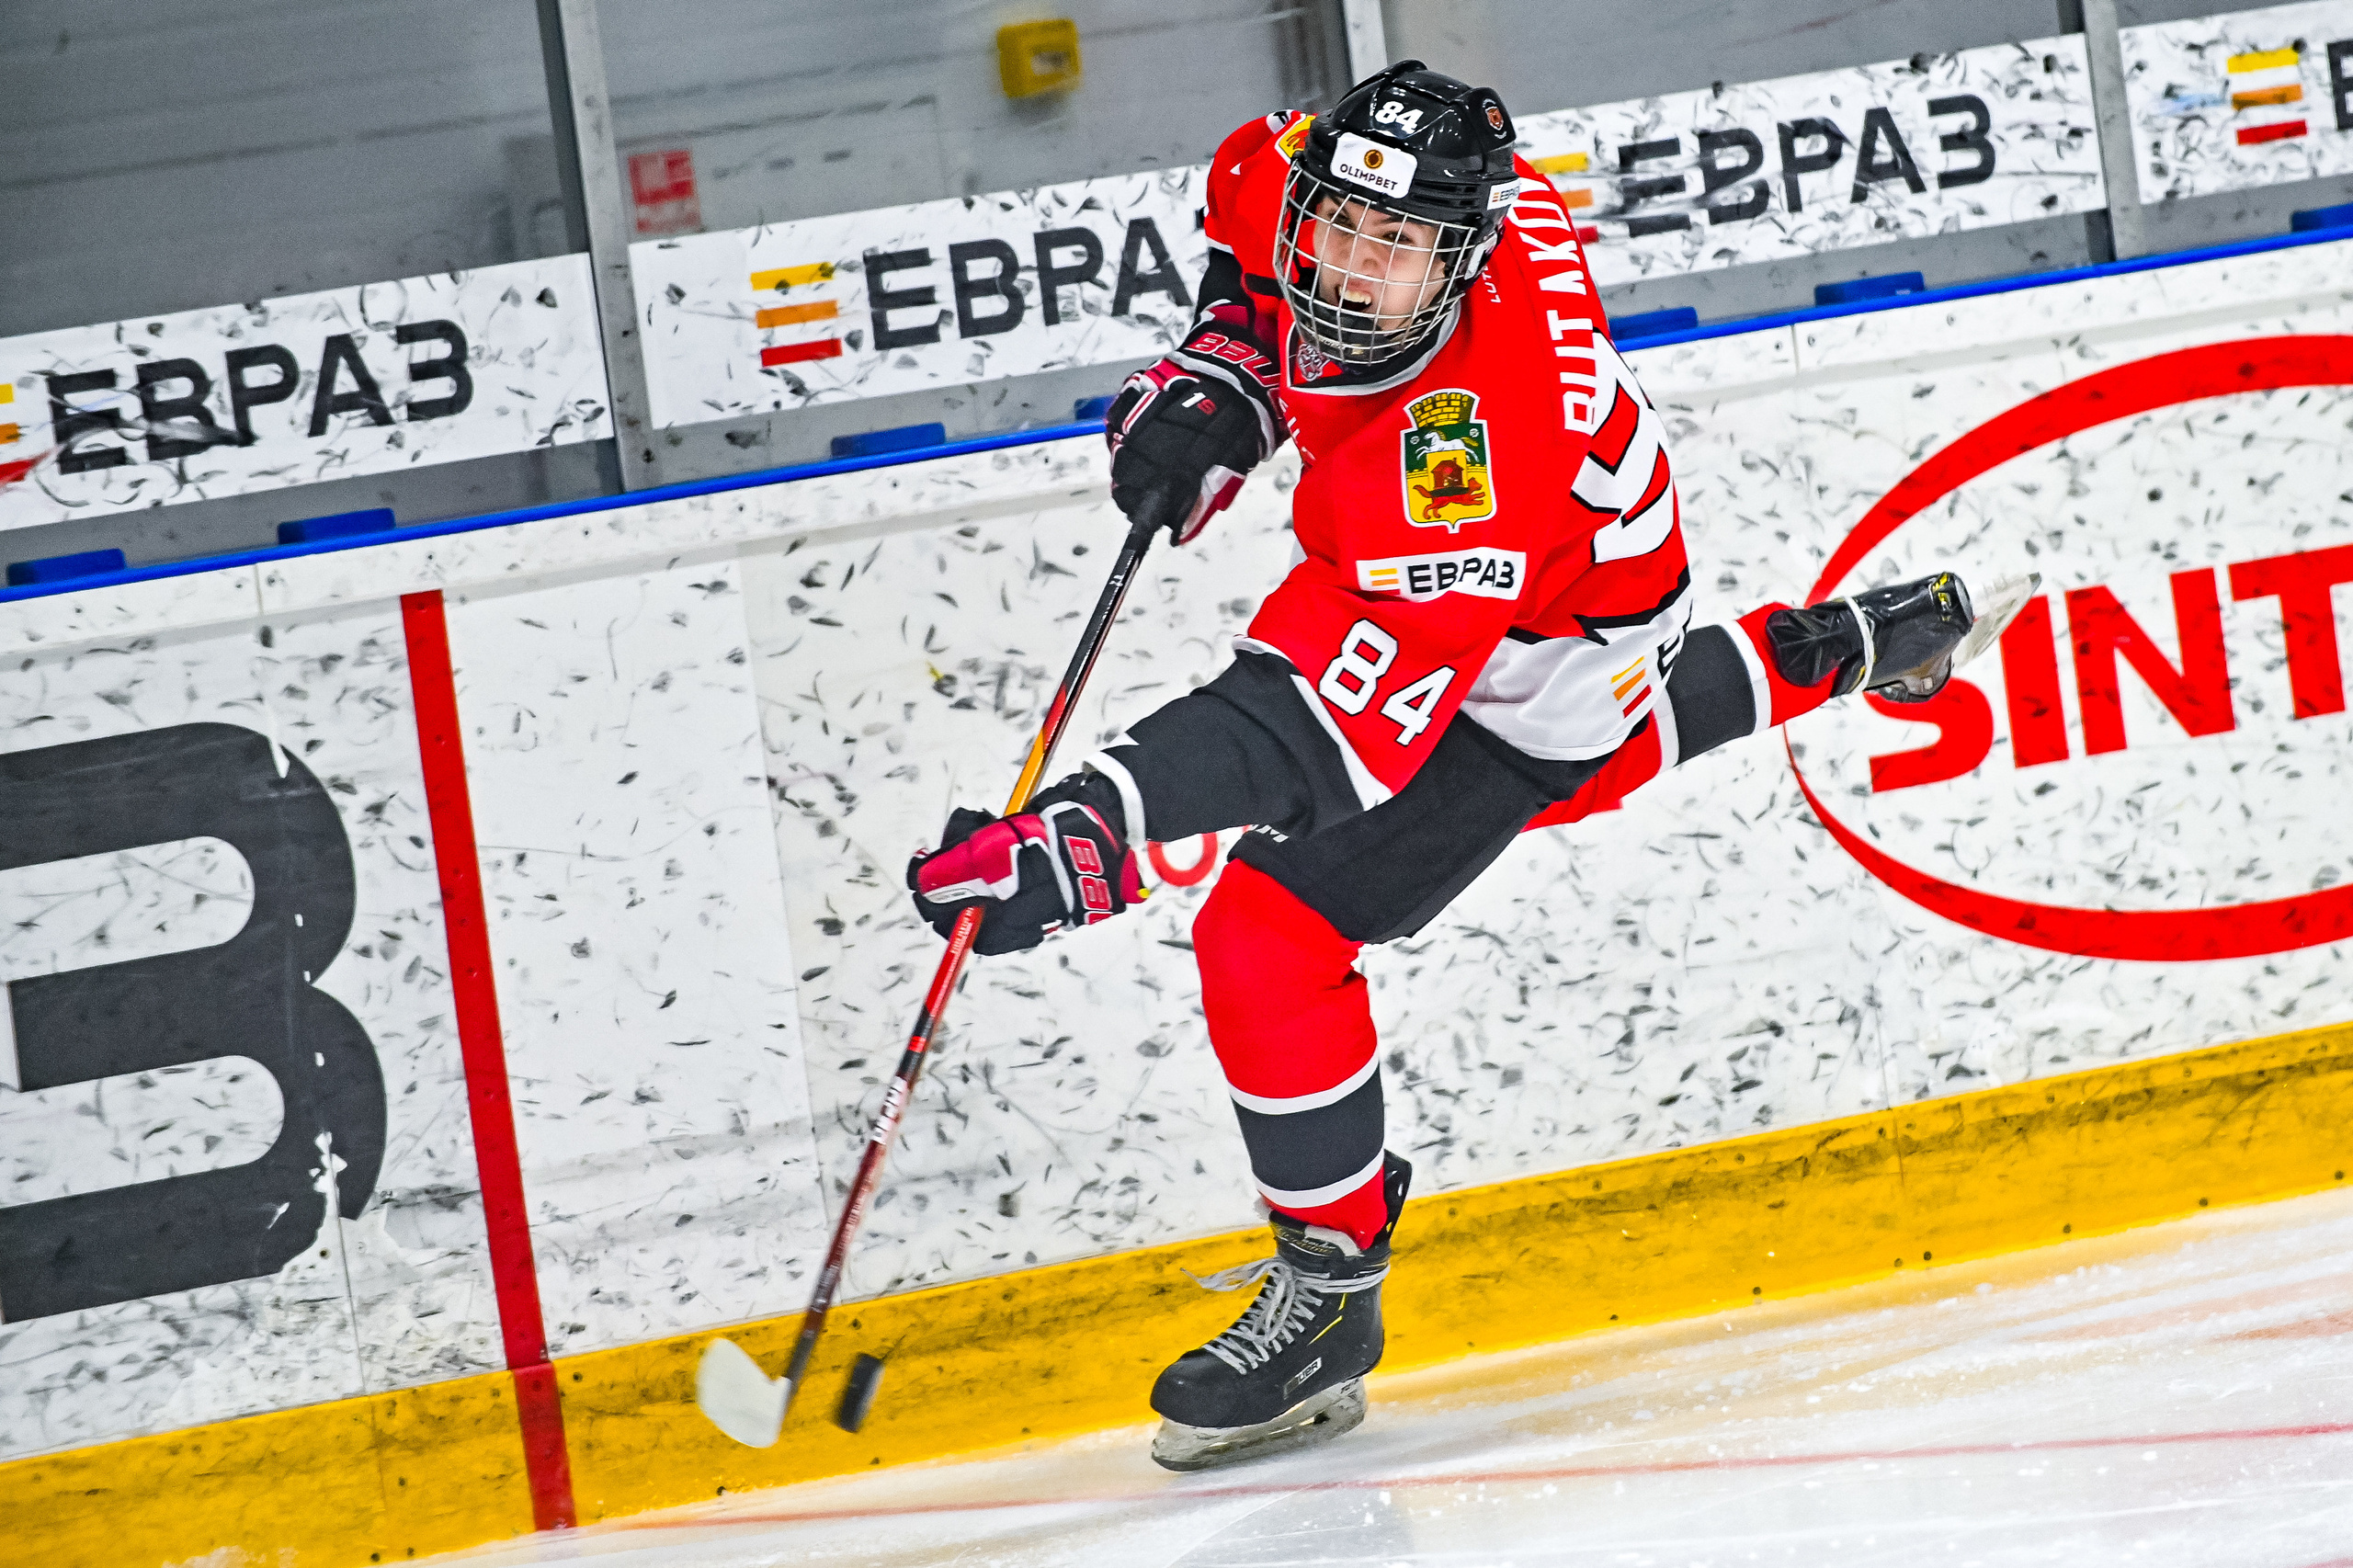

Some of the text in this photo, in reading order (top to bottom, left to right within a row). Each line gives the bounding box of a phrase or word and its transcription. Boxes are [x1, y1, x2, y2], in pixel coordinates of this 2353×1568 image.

[1340, 164, 1398, 190] OLIMPBET
[1375, 100, 1424, 133] 84
[1618, 93, 1996, 236] ЕВРАЗ
[863, 208, 1206, 350] ЕВРА
[46, 318, 474, 474] ЕВРАЗ
[1407, 557, 1515, 594] ЕВРАЗ
[1318, 618, 1457, 746] 84
